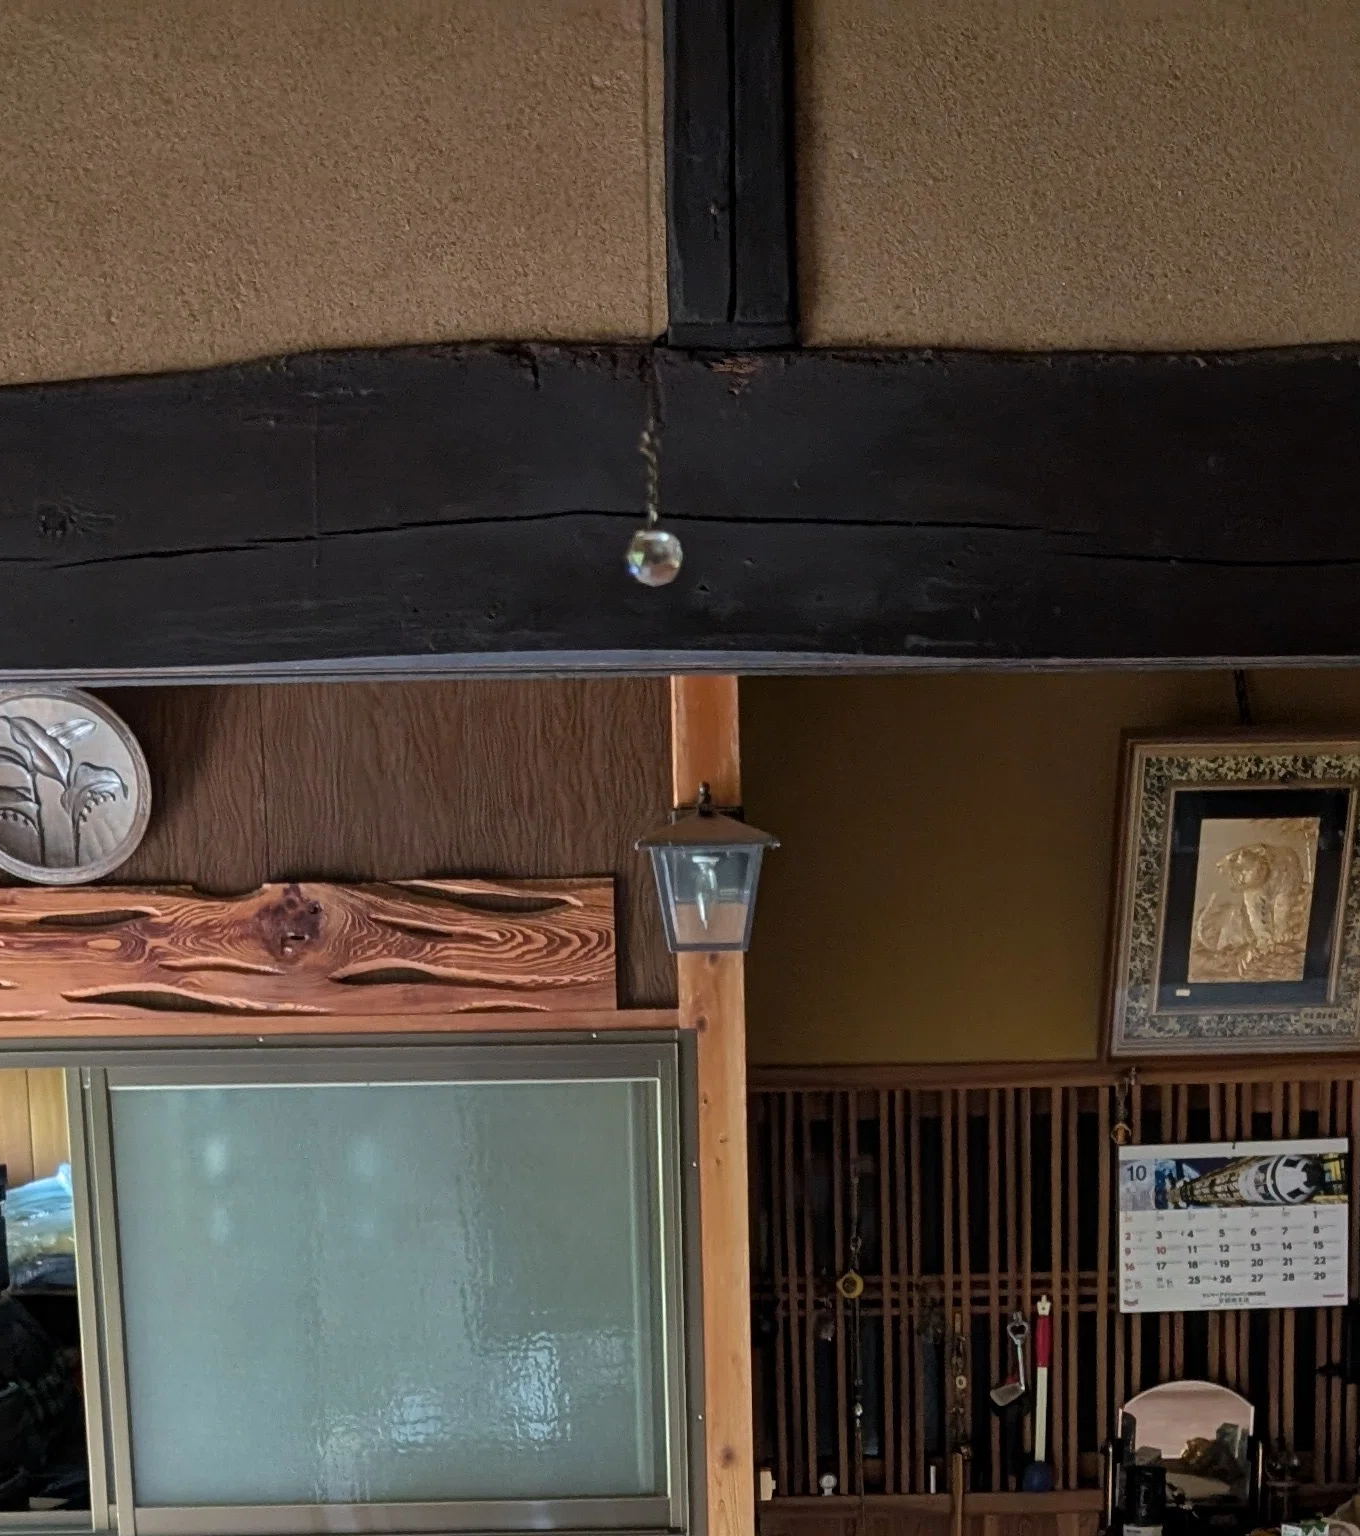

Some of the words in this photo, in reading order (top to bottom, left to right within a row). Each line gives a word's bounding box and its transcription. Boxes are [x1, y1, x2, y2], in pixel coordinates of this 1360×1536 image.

[1127, 1165, 1147, 1182] 10
[1219, 1244, 1229, 1252] 12
[1251, 1243, 1261, 1251] 13
[1282, 1242, 1292, 1250] 14
[1313, 1241, 1324, 1249] 15
[1125, 1263, 1135, 1271] 16
[1157, 1262, 1167, 1270] 17
[1251, 1259, 1263, 1267] 20
[1283, 1257, 1292, 1266] 21
[1314, 1256, 1326, 1265] 22
[1189, 1276, 1200, 1284] 25
[1220, 1275, 1232, 1283] 26
[1252, 1274, 1263, 1282] 27
[1283, 1273, 1294, 1281] 28
[1314, 1272, 1326, 1280] 29
